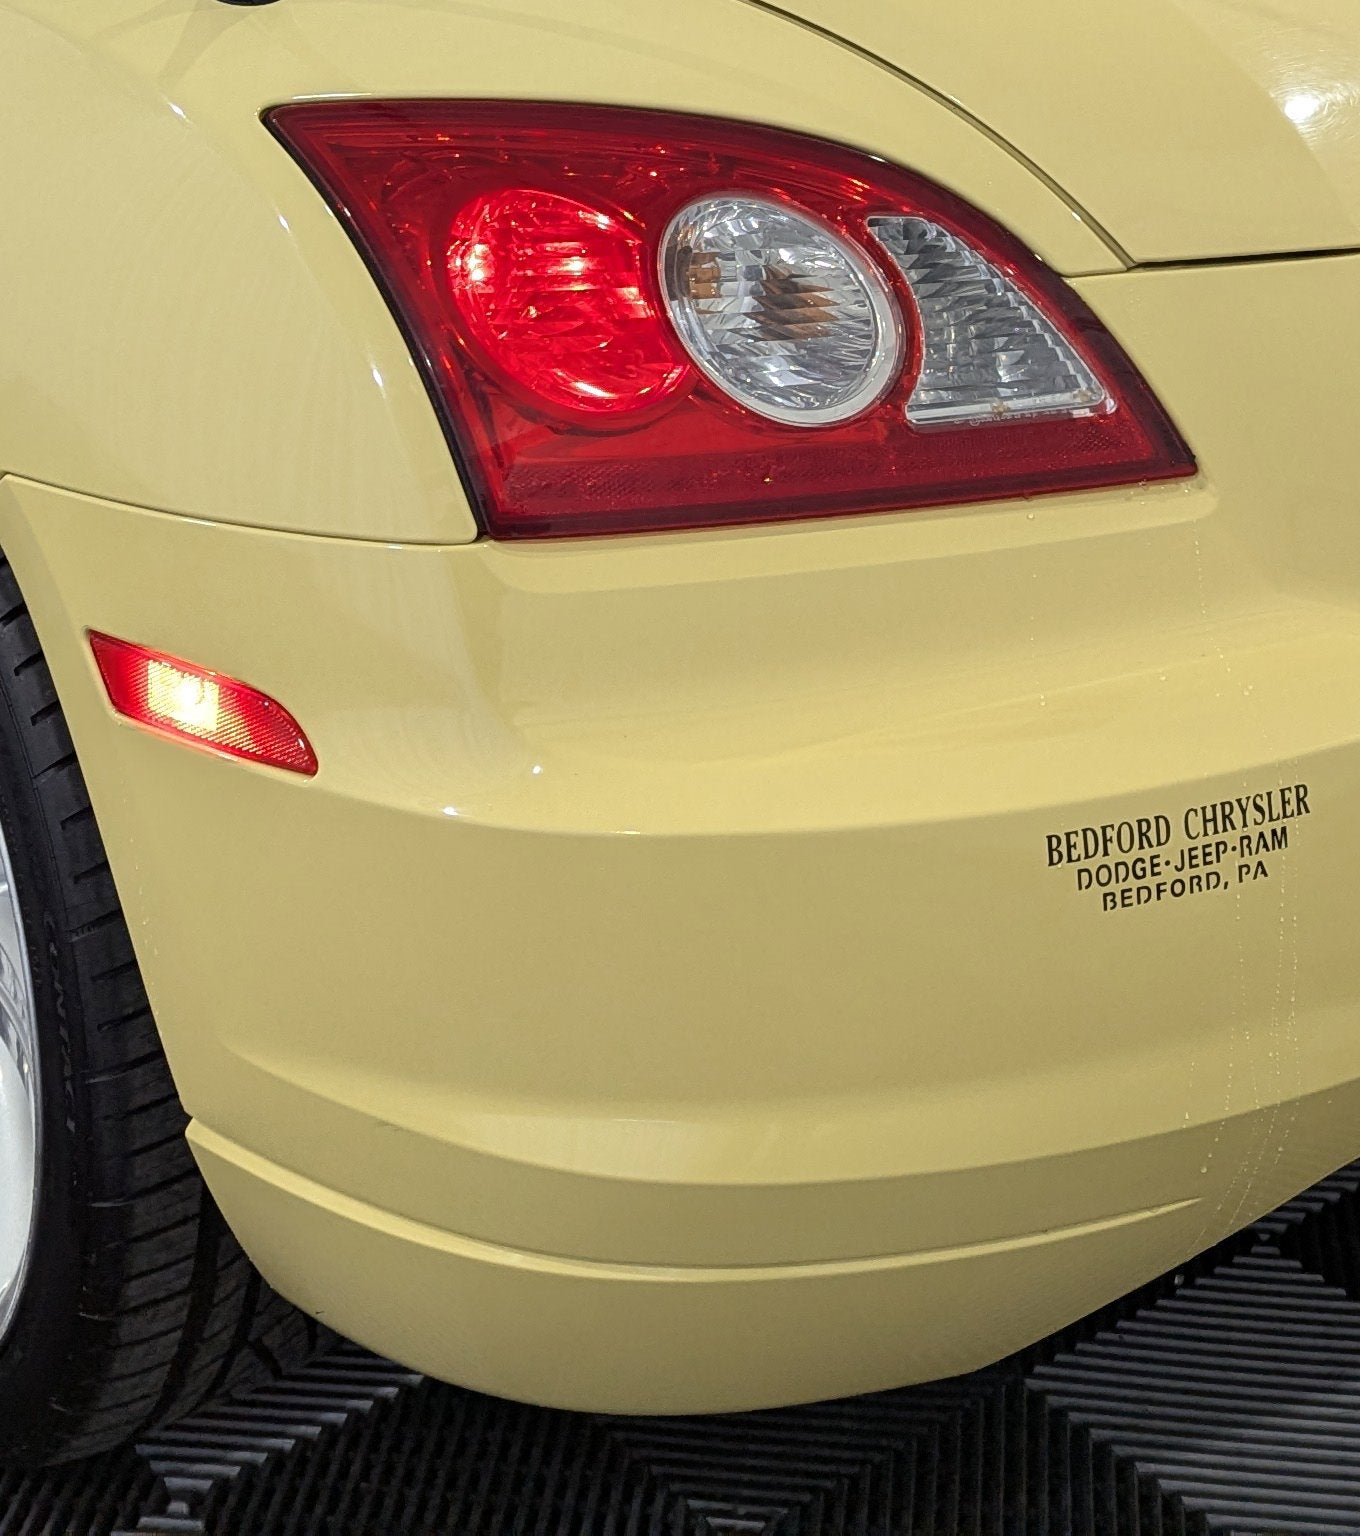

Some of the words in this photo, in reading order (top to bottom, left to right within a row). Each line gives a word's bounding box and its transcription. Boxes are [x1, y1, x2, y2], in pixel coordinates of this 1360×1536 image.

[1045, 814, 1172, 867] BEDFORD
[1183, 783, 1311, 841] CHRYSLER
[1102, 870, 1230, 912] BEDFORD,
[1237, 860, 1269, 884] PA
